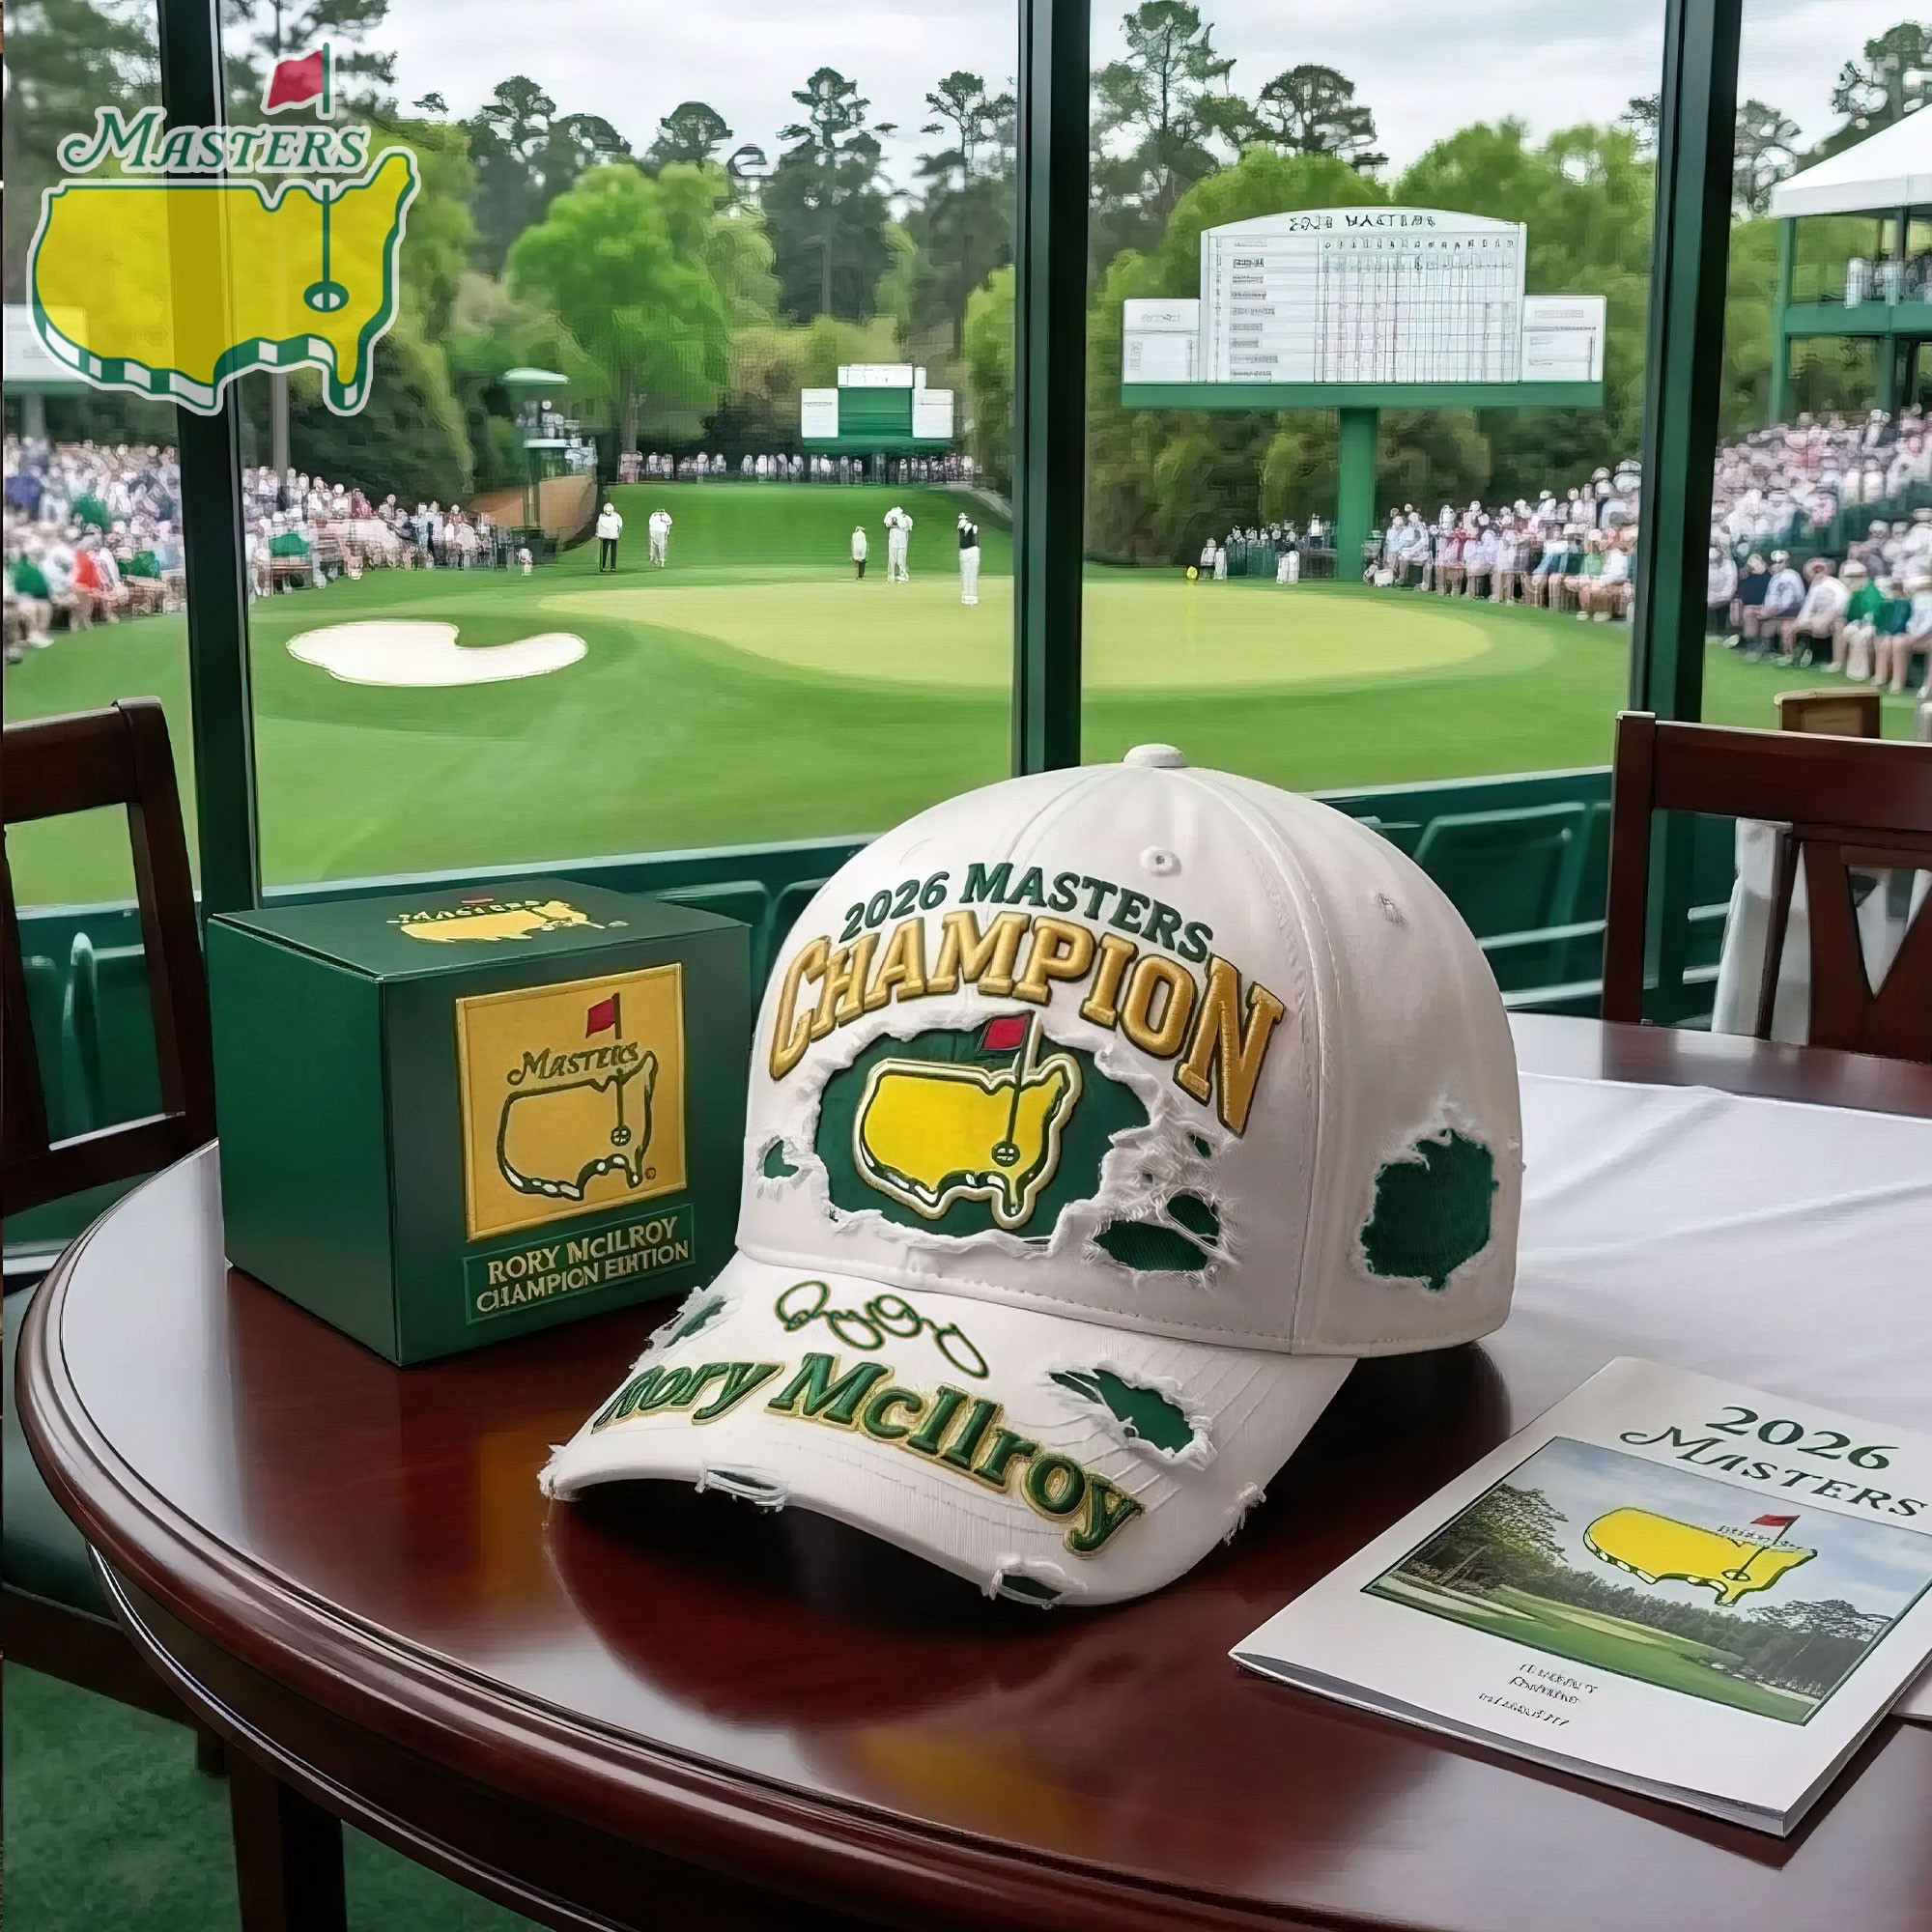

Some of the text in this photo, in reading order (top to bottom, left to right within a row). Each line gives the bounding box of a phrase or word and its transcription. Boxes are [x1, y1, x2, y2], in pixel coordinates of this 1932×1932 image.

[838, 862, 1214, 963] 2026 MASTERS
[769, 910, 1286, 1138] CHAMPION
[487, 1244, 562, 1286] RORY
[762, 1352, 1147, 1560] McIlroy
[1705, 1406, 1901, 1470] 2026
